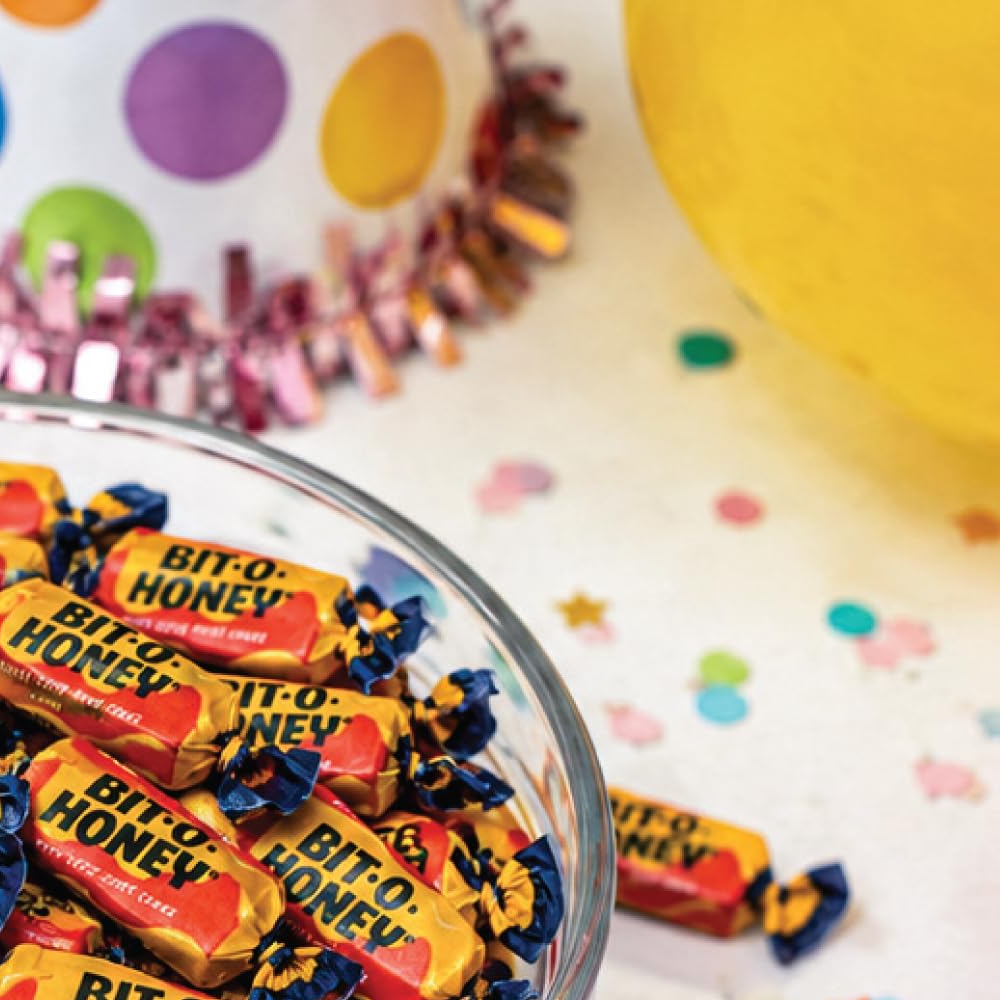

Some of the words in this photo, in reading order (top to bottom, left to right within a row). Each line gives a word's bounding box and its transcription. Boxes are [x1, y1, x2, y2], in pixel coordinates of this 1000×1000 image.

[128, 571, 287, 618] HONEY
[8, 617, 174, 698] HONEY
[40, 791, 211, 890] HONEY
[266, 844, 405, 953] HONEY
